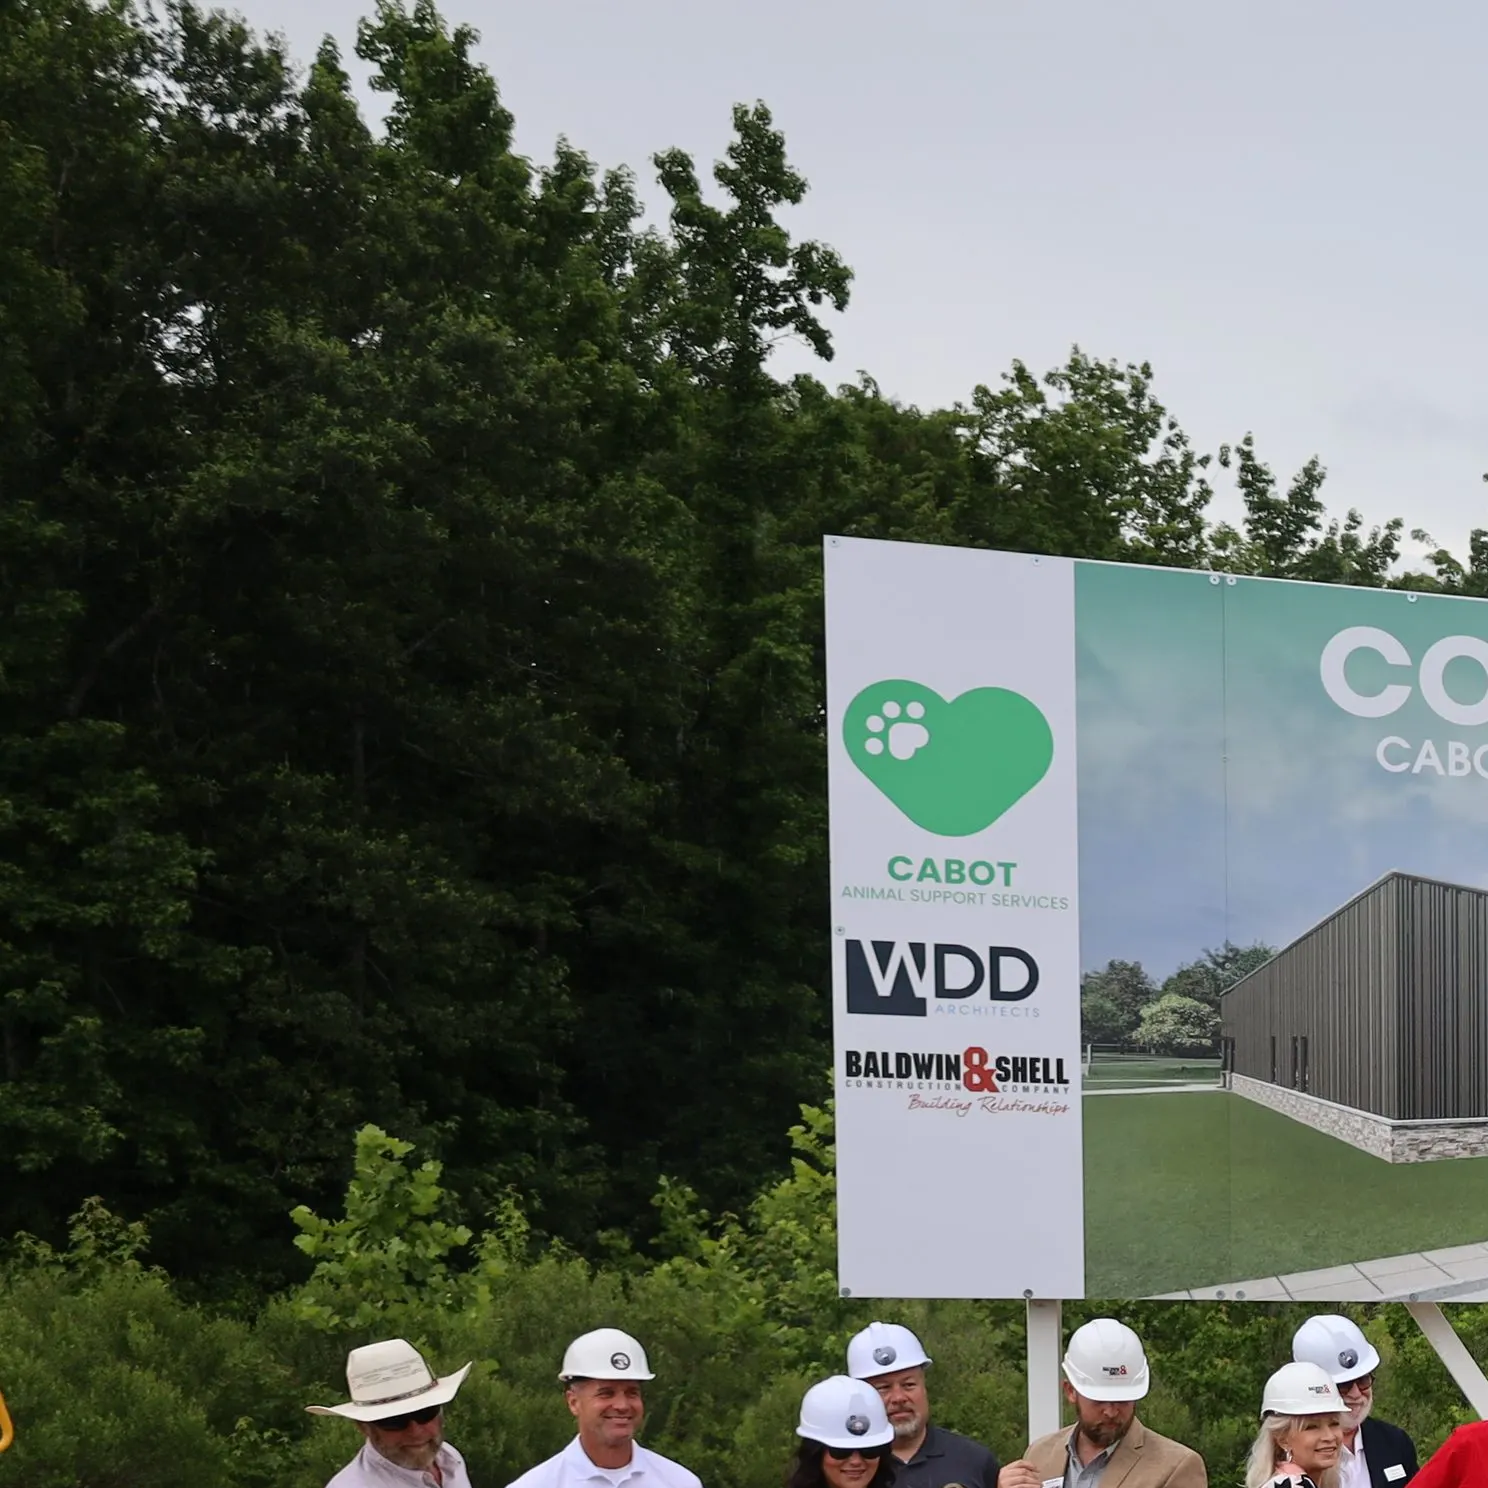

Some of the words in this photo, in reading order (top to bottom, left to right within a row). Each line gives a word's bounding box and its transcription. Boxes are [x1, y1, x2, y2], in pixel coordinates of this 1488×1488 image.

[887, 855, 1017, 887] CABOT
[841, 886, 904, 901] ANIMAL
[910, 889, 985, 905] SUPPORT
[991, 893, 1069, 910] SERVICES
[846, 939, 1039, 1003] WDD
[935, 1004, 1041, 1017] ARCHITECTS
[845, 1079, 961, 1091] CONSTRUCTION
[1002, 1084, 1069, 1094] COMPANY
[907, 1093, 972, 1117] Building
[976, 1096, 1070, 1114] Relationships
